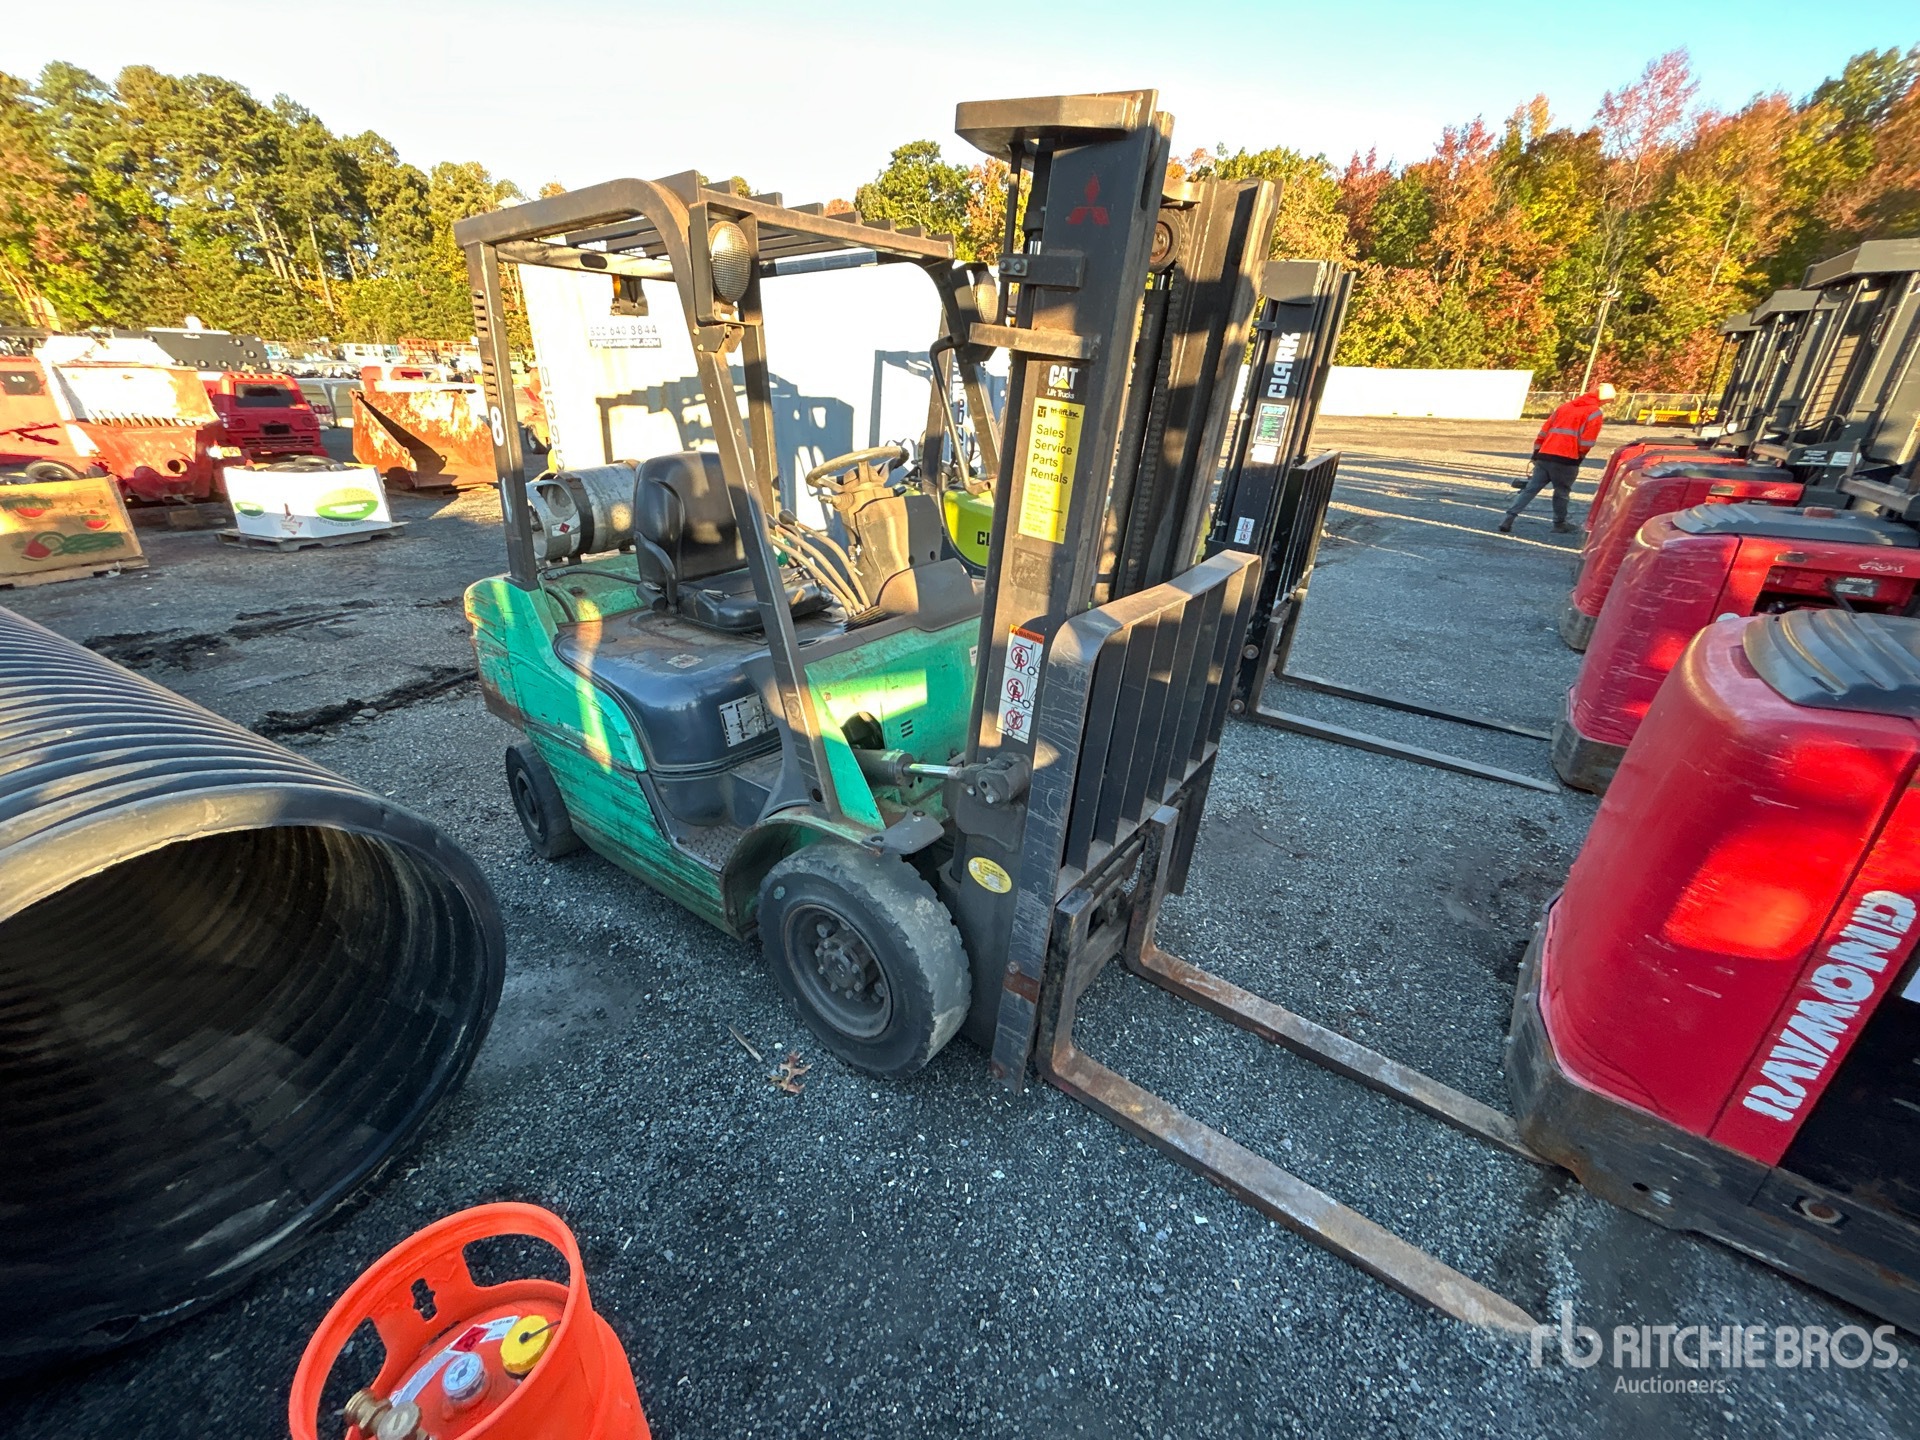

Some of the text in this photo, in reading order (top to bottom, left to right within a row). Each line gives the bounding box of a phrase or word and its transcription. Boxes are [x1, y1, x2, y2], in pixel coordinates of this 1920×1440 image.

[1267, 332, 1301, 399] CLARK
[1048, 364, 1079, 390] CAT
[1047, 388, 1075, 399] Lift Trucks
[1036, 424, 1065, 439] Sales
[1034, 438, 1073, 456] Service
[1032, 453, 1059, 468] Parts
[1030, 467, 1068, 485] Rentals
[1742, 889, 1917, 1122] RAYMOND
